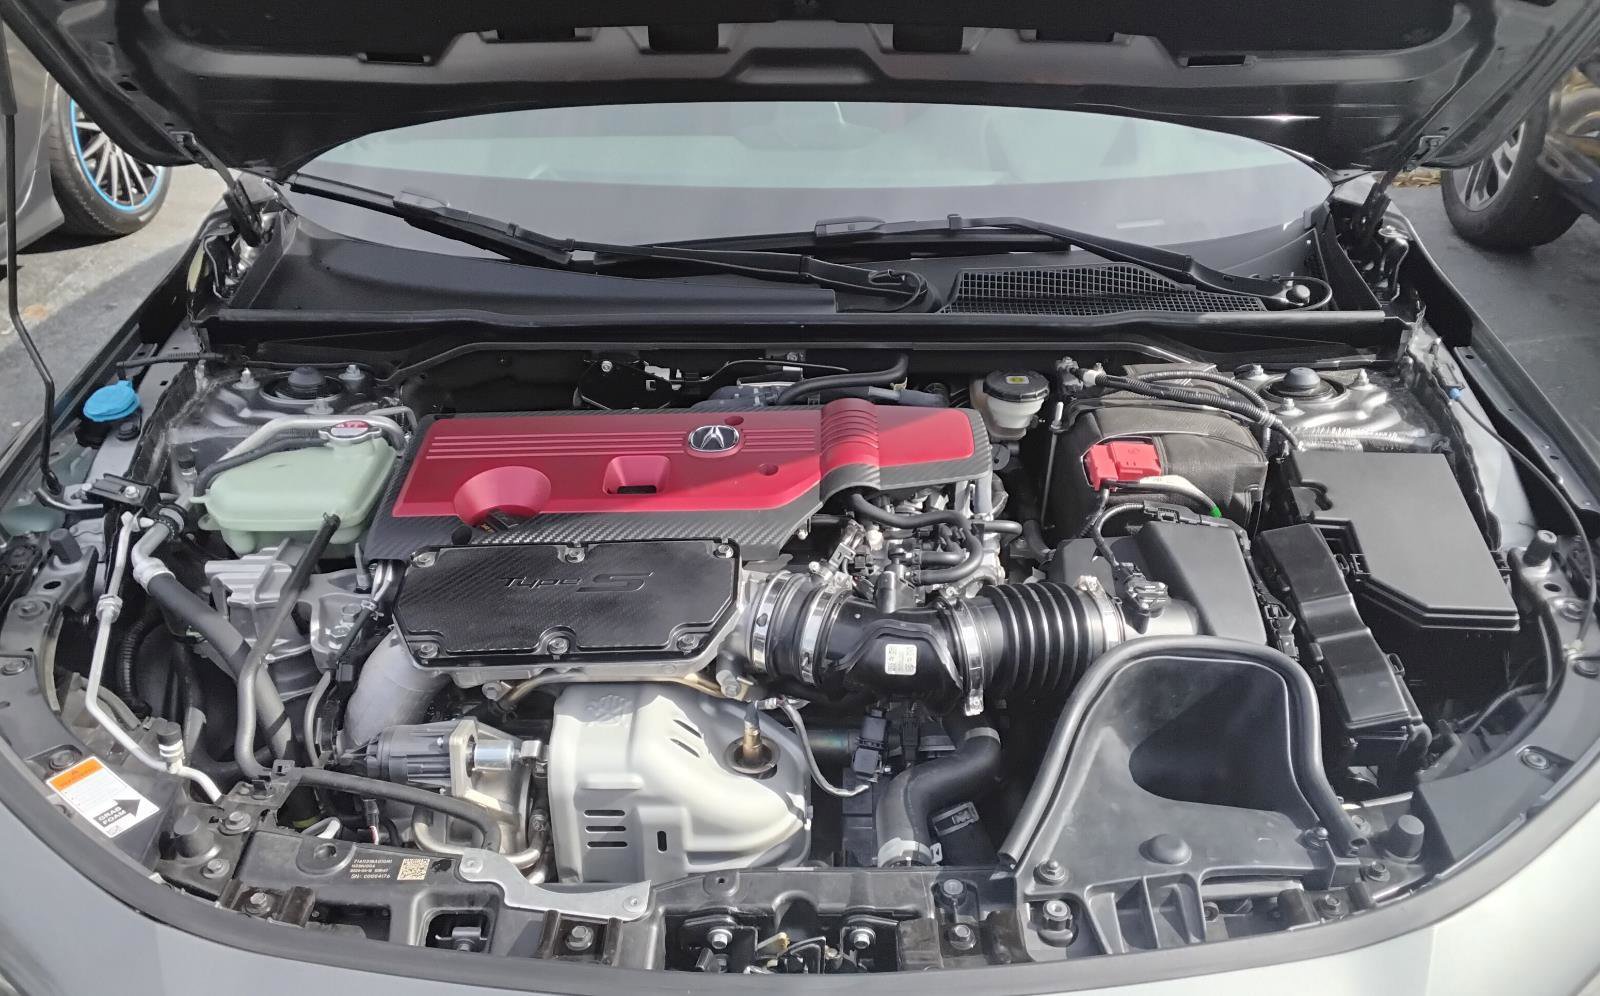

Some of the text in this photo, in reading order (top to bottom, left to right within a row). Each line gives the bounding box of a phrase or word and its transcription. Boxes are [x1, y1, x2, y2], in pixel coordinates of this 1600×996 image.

[500, 571, 655, 593] Type S
[98, 806, 122, 821] GRAB
[102, 809, 127, 825] FOAM
